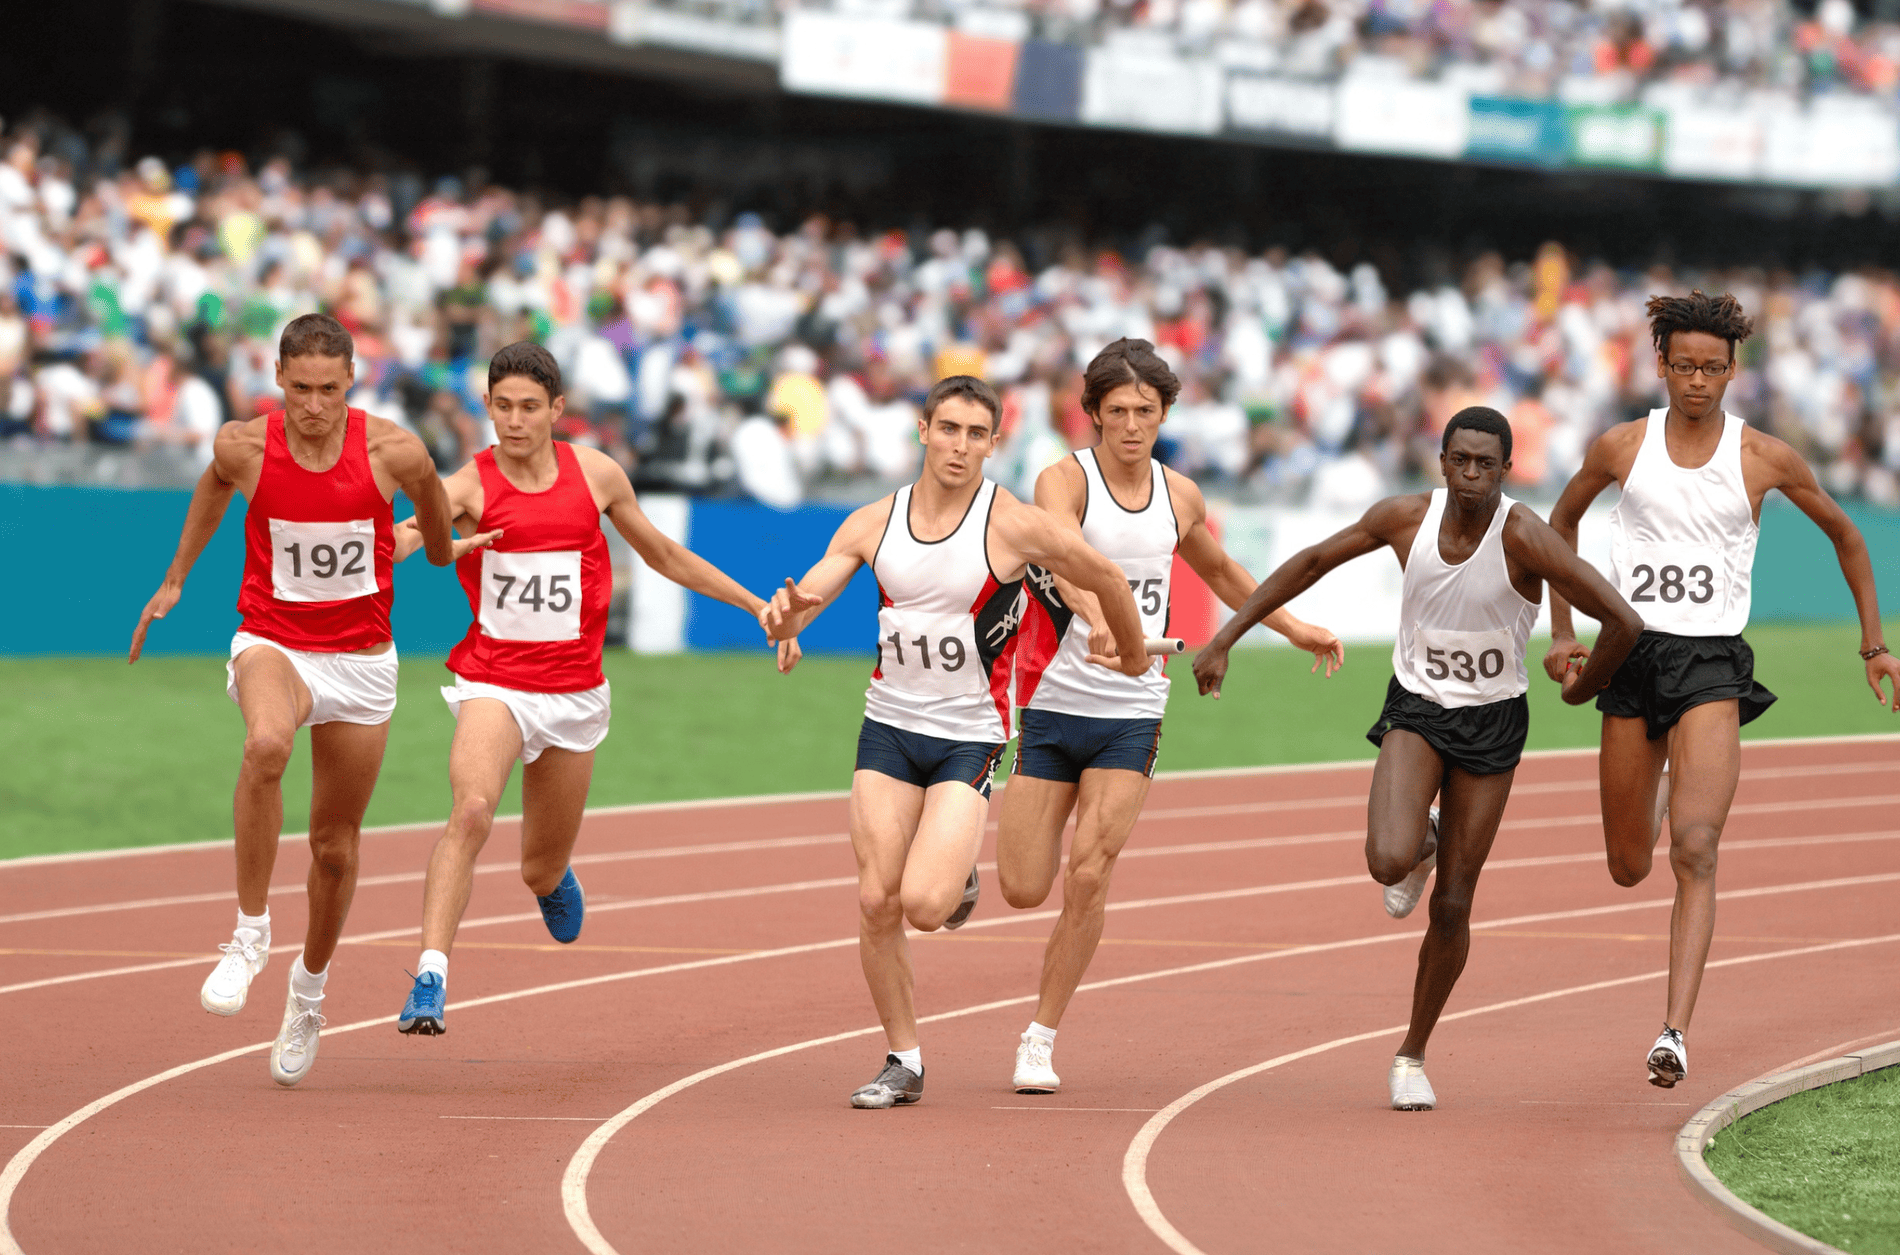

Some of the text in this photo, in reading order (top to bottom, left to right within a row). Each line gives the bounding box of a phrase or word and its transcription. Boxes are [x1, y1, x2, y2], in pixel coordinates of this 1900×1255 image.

[283, 540, 367, 579] 192
[492, 573, 573, 613] 745
[1630, 564, 1715, 604] 283
[886, 631, 967, 673] 119
[1424, 645, 1505, 684] 530
